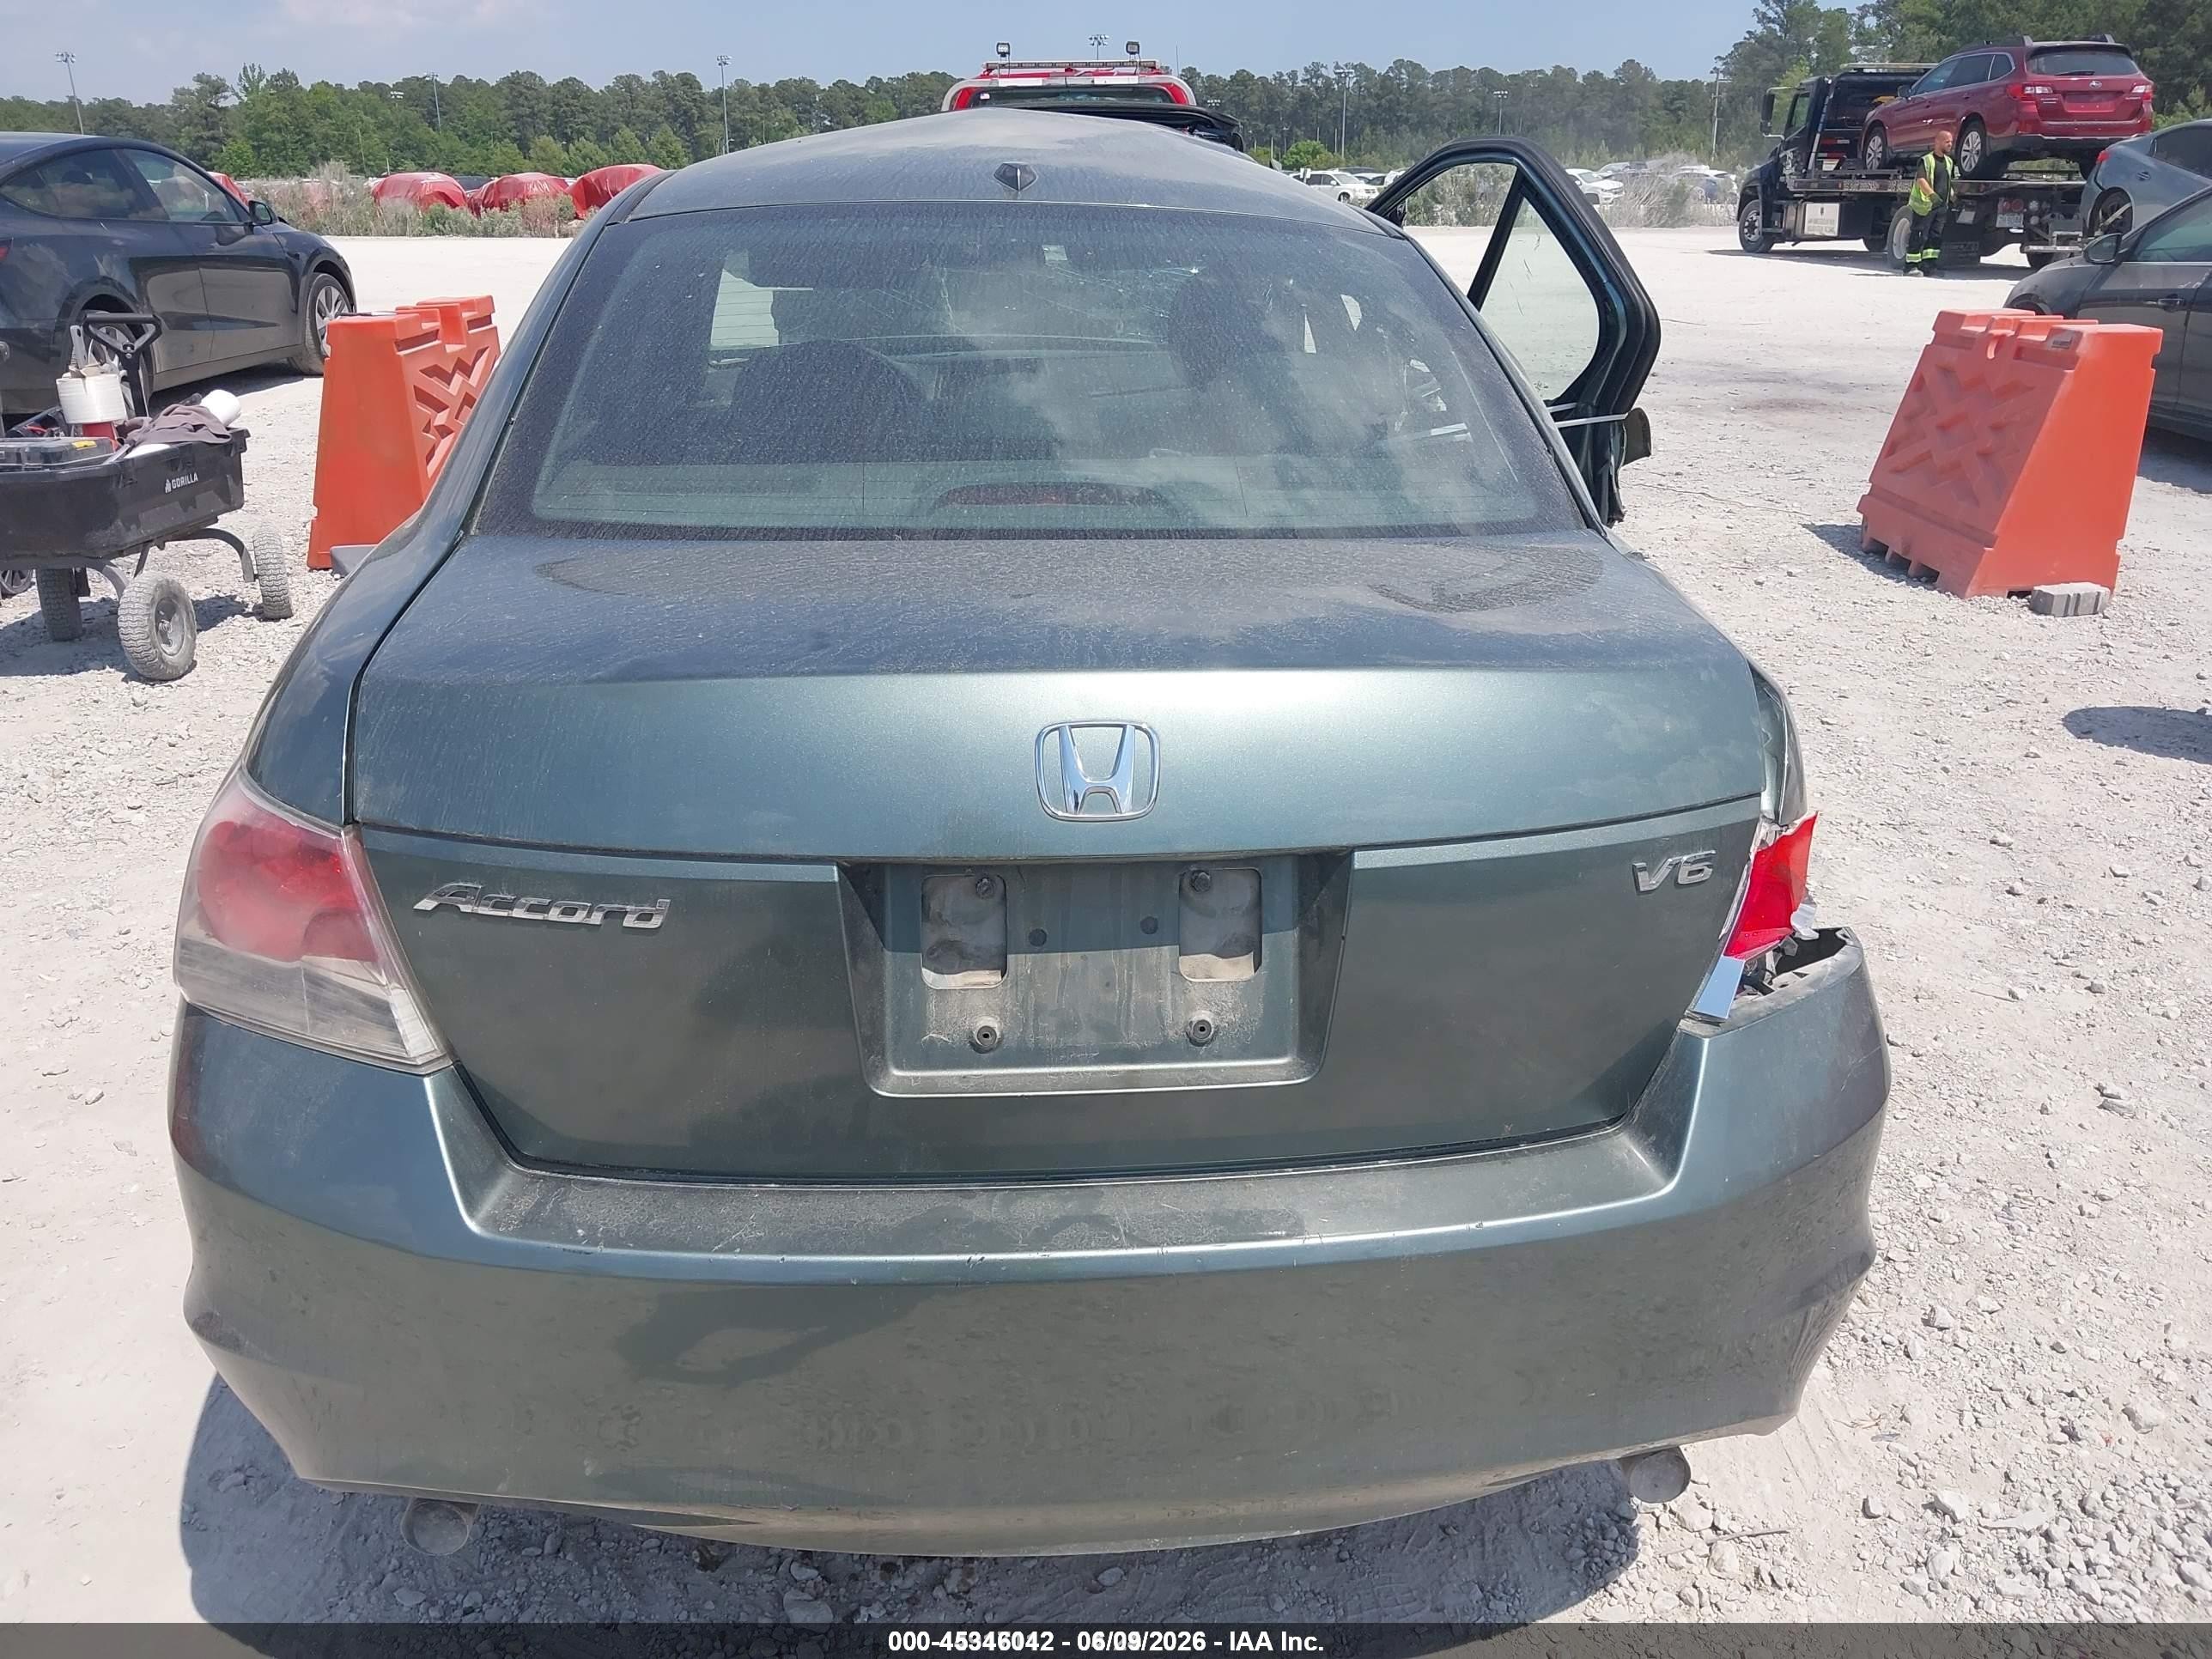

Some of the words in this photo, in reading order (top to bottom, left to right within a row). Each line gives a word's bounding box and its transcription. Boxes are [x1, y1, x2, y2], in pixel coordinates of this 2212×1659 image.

[171, 471, 199, 489] GORILLA
[1632, 849, 1716, 892] V6
[412, 883, 672, 929] Accord
